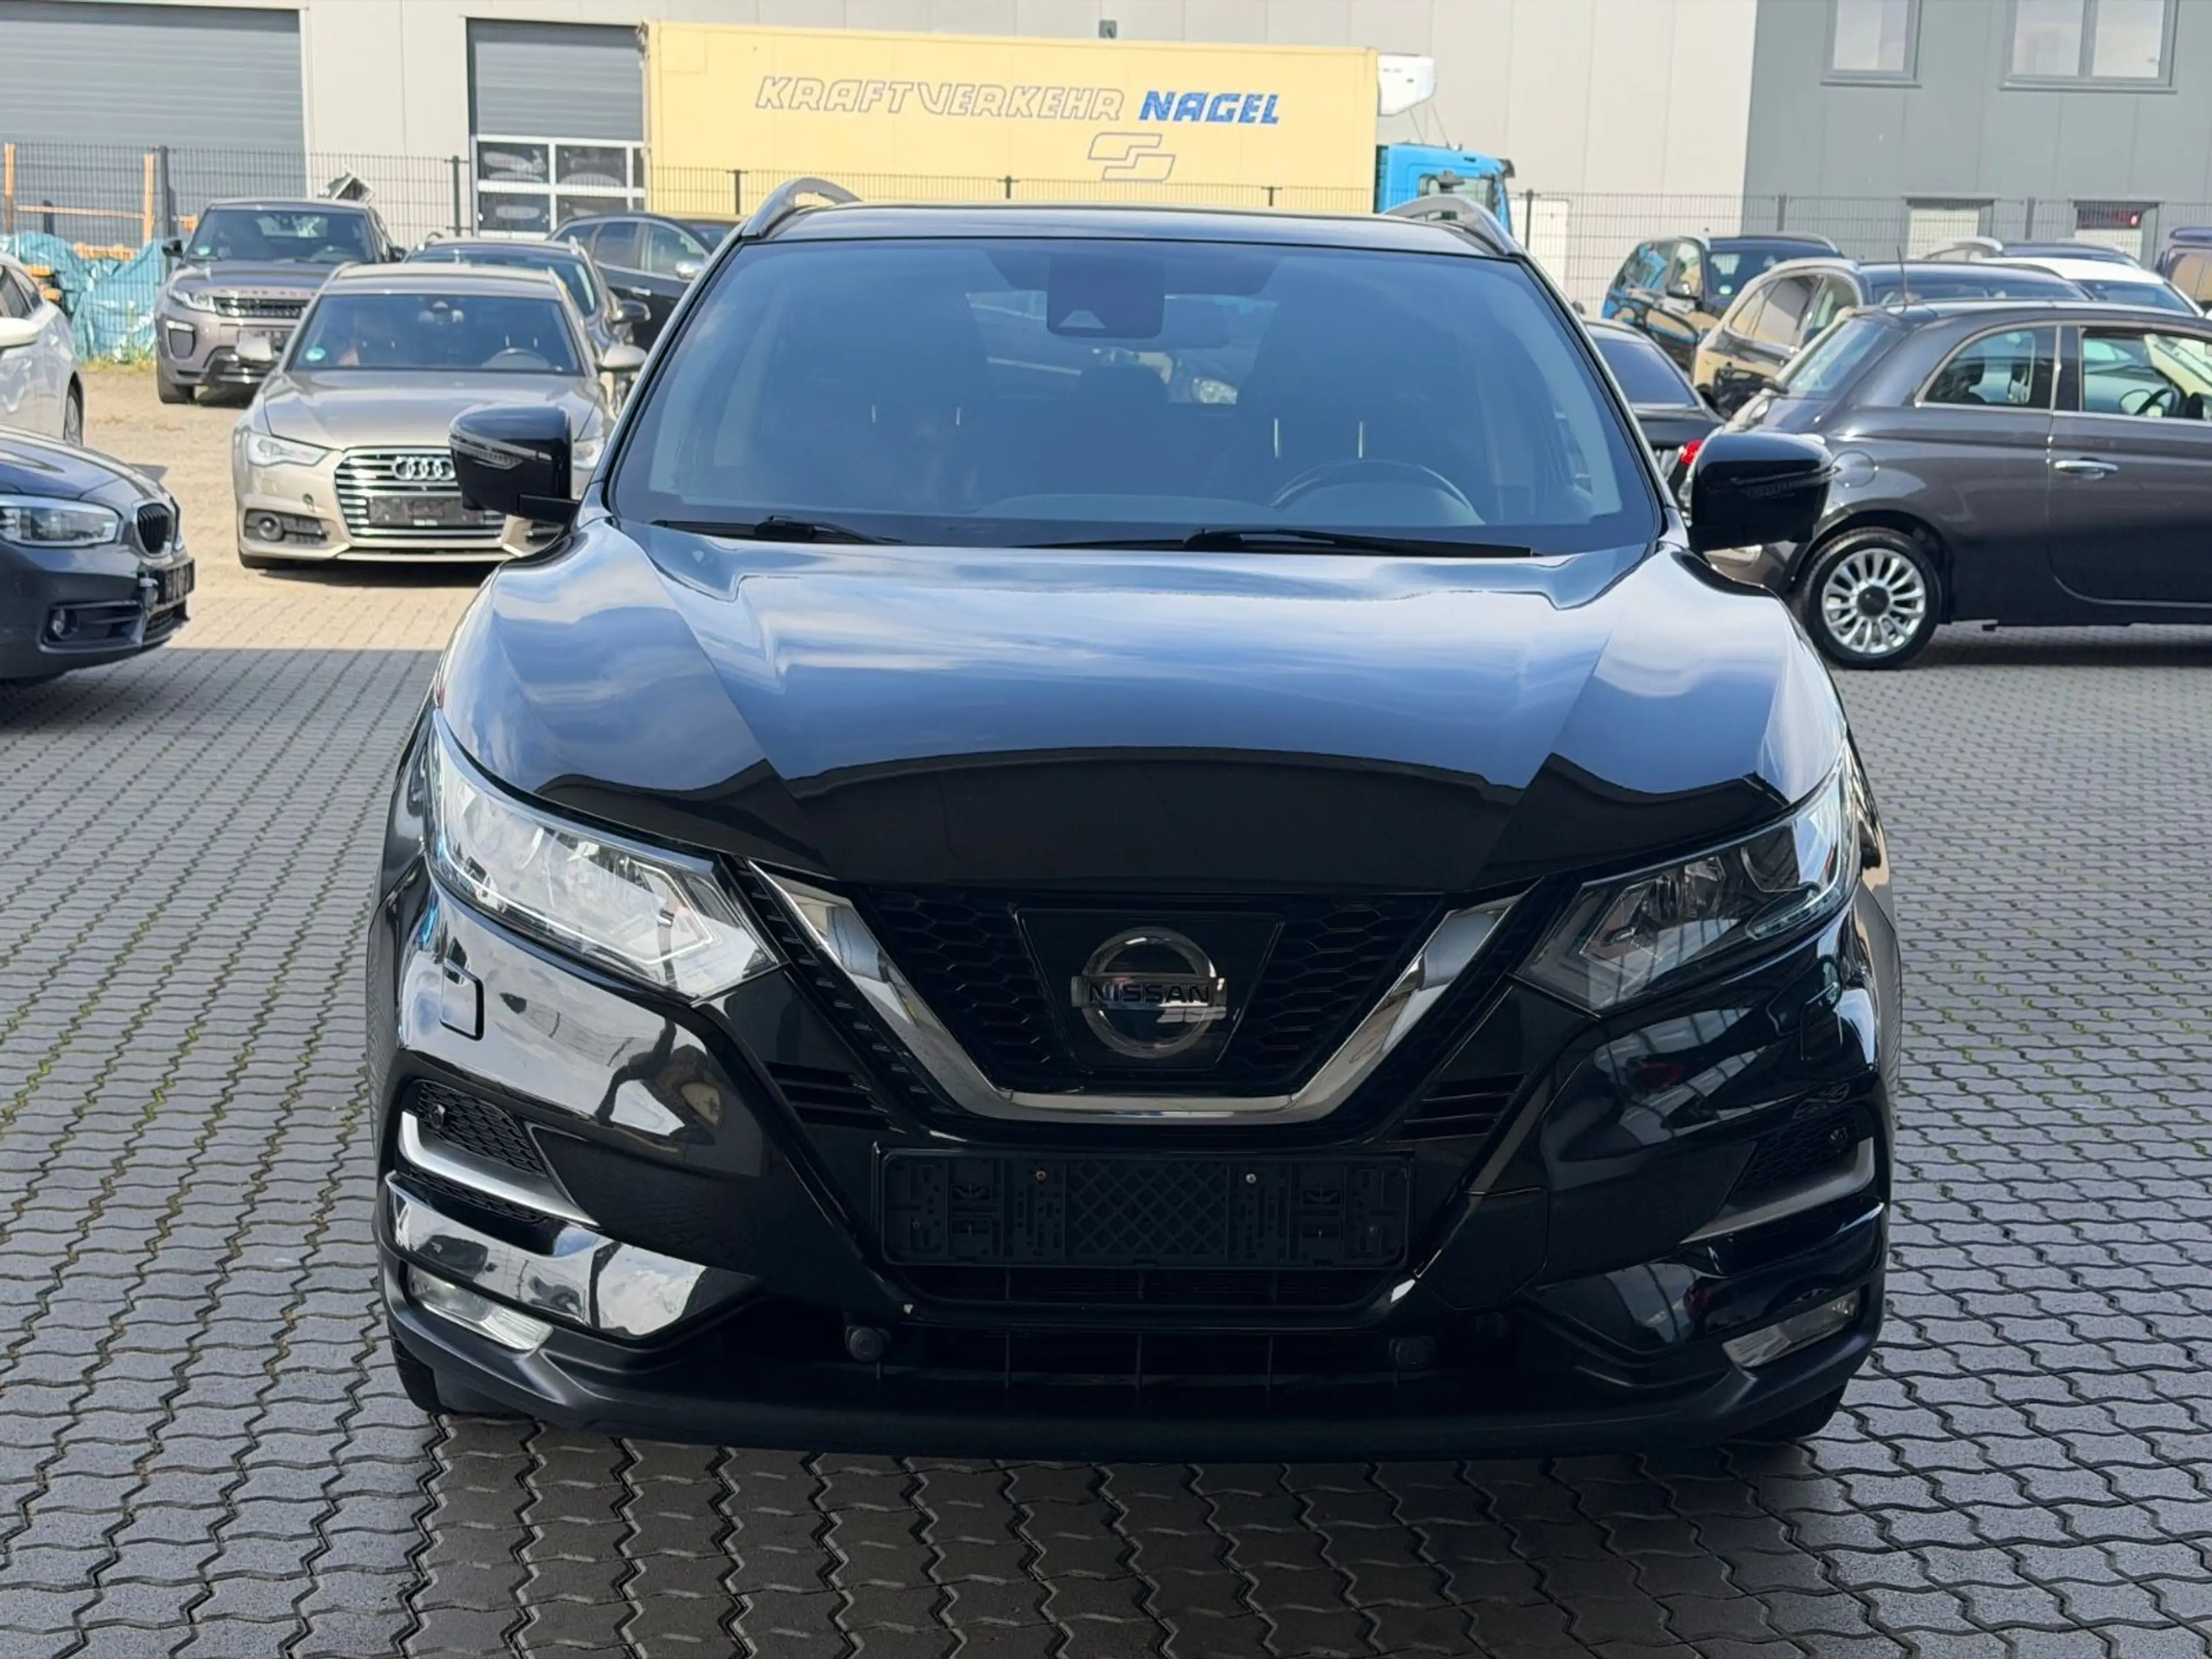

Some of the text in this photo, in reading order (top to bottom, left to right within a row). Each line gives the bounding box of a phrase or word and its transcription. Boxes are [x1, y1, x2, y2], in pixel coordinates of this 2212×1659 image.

[755, 76, 1279, 123] KRAFTVERKEHR NAGEL
[1089, 983, 1209, 1003] NISSAN
